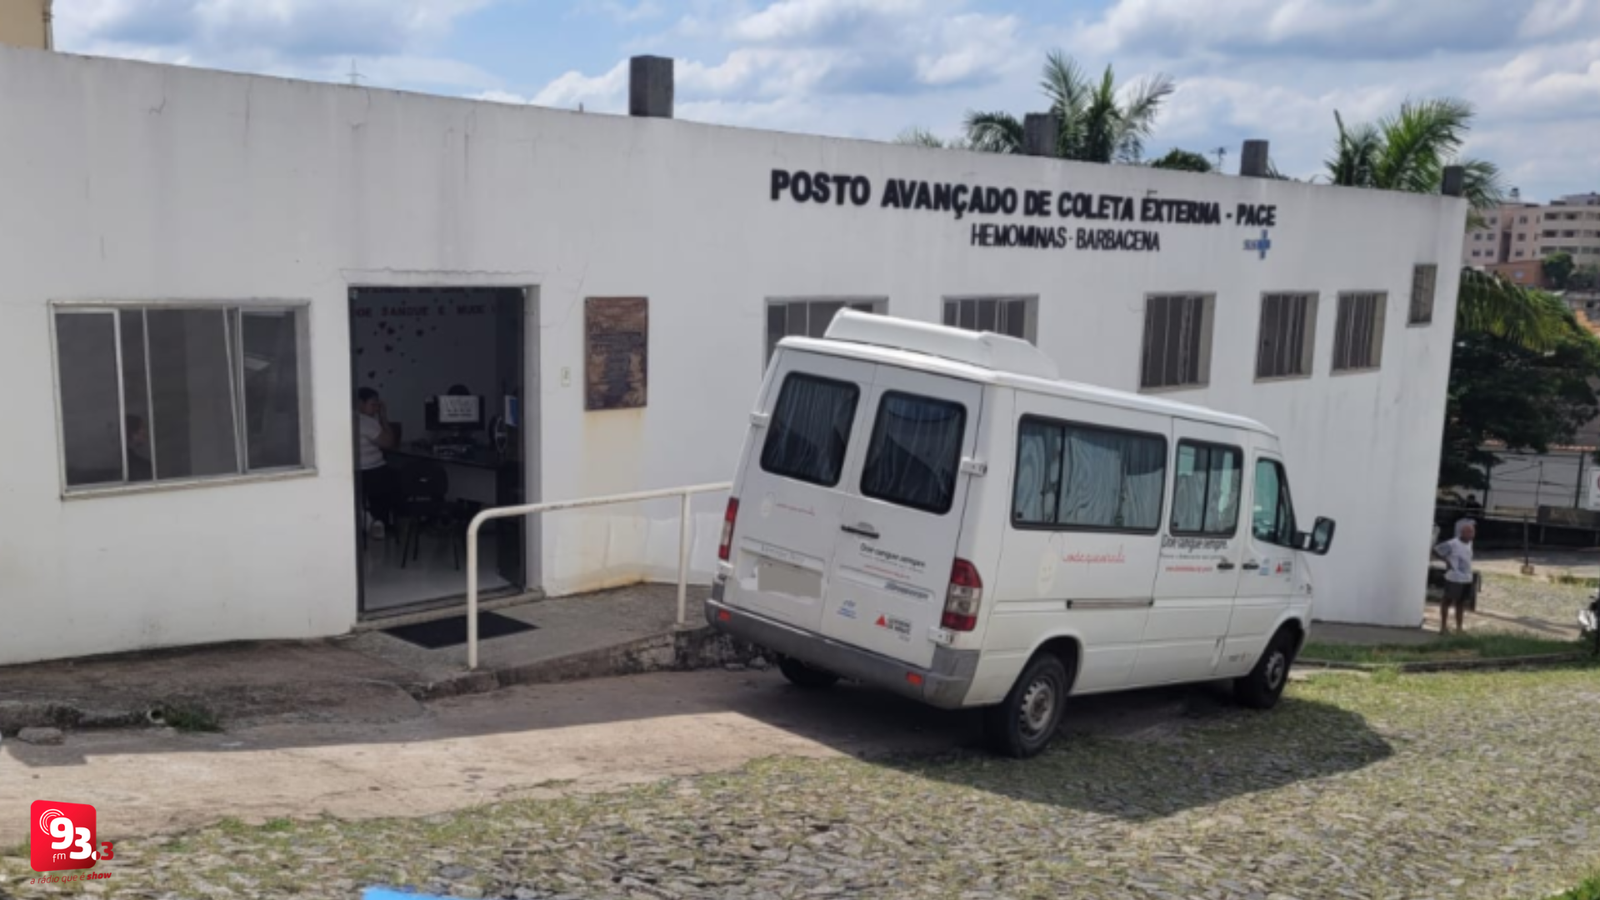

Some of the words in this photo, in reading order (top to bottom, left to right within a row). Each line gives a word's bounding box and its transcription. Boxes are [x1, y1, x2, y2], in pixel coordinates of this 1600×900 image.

[770, 168, 871, 206] POSTO
[880, 178, 1018, 220] AVANÇADO
[1023, 190, 1052, 217] DE
[1057, 191, 1135, 222] COLETA
[1140, 199, 1221, 226] EXTERNA
[1236, 203, 1277, 227] PACE
[970, 222, 1067, 250] HEMOMINAS
[1076, 226, 1160, 252] BARBACENA
[381, 306, 428, 316] SANGUE
